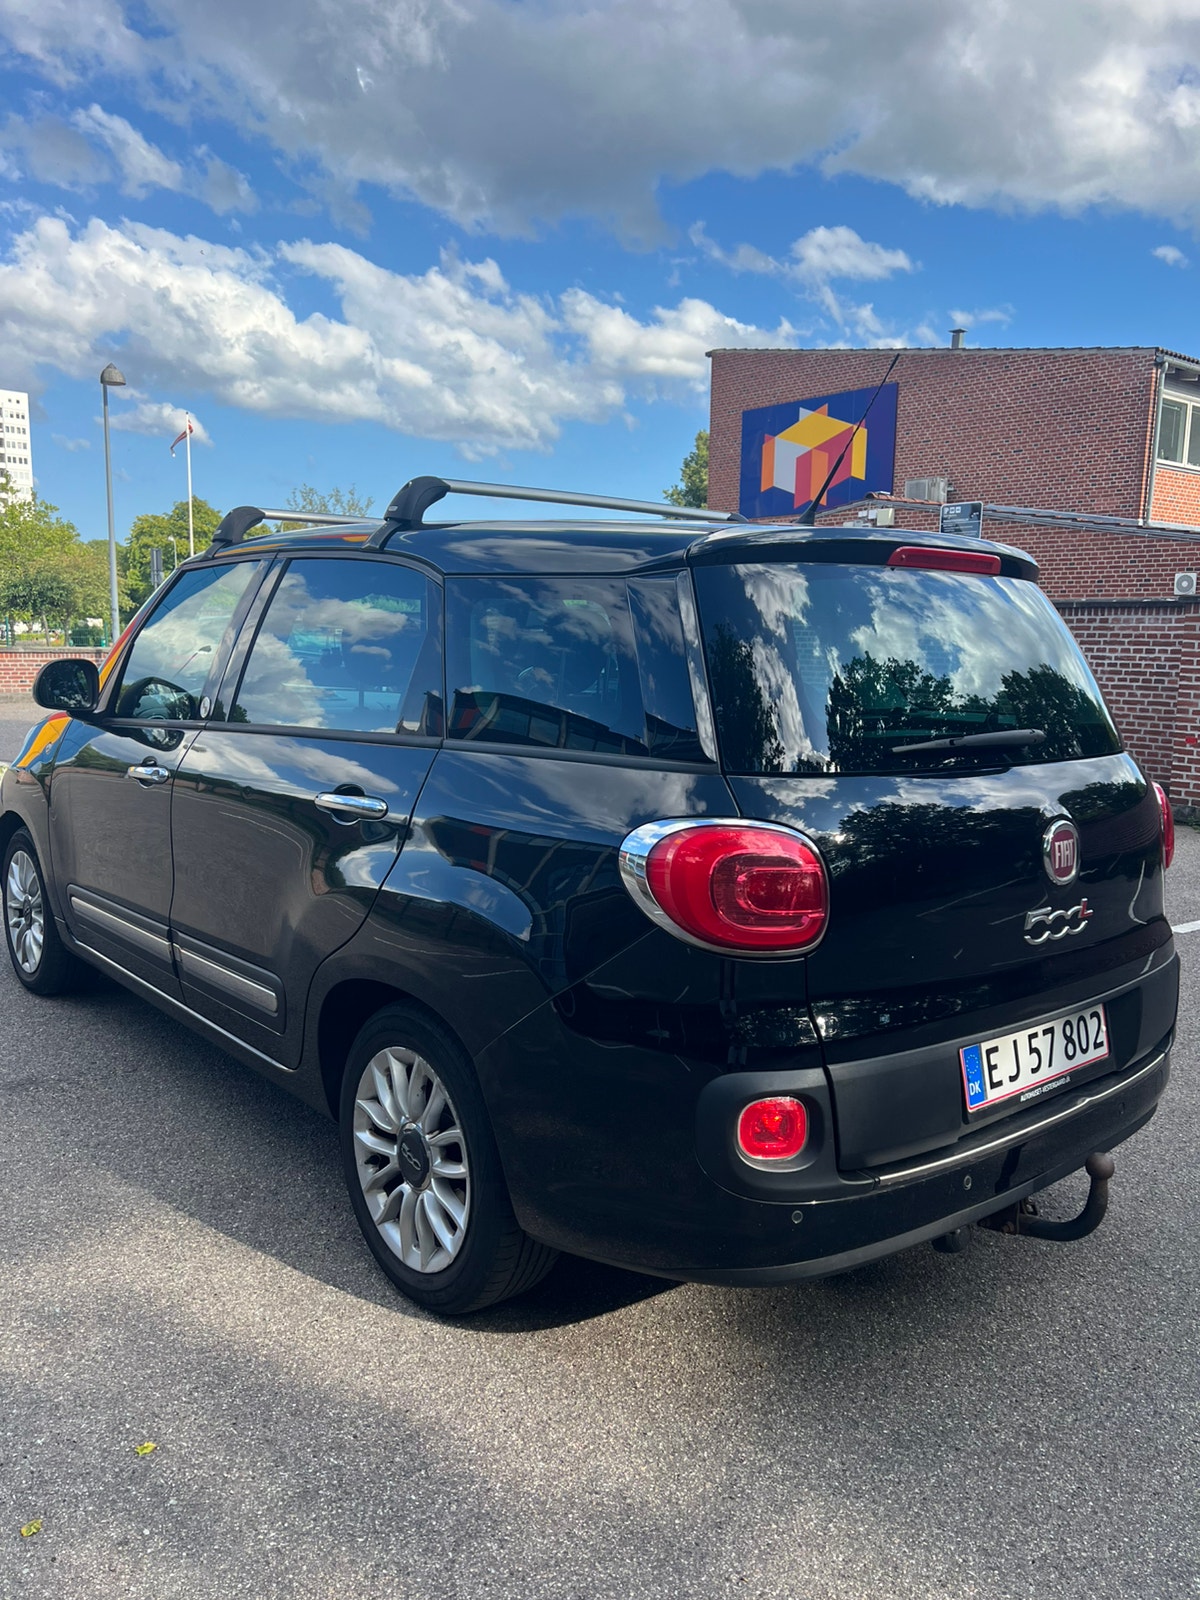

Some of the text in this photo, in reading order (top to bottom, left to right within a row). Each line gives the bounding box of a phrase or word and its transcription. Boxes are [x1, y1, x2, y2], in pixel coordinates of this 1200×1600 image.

[1055, 838, 1074, 869] FIAT
[985, 1010, 1104, 1090] EJ 57 802
[969, 1080, 982, 1096] DK
